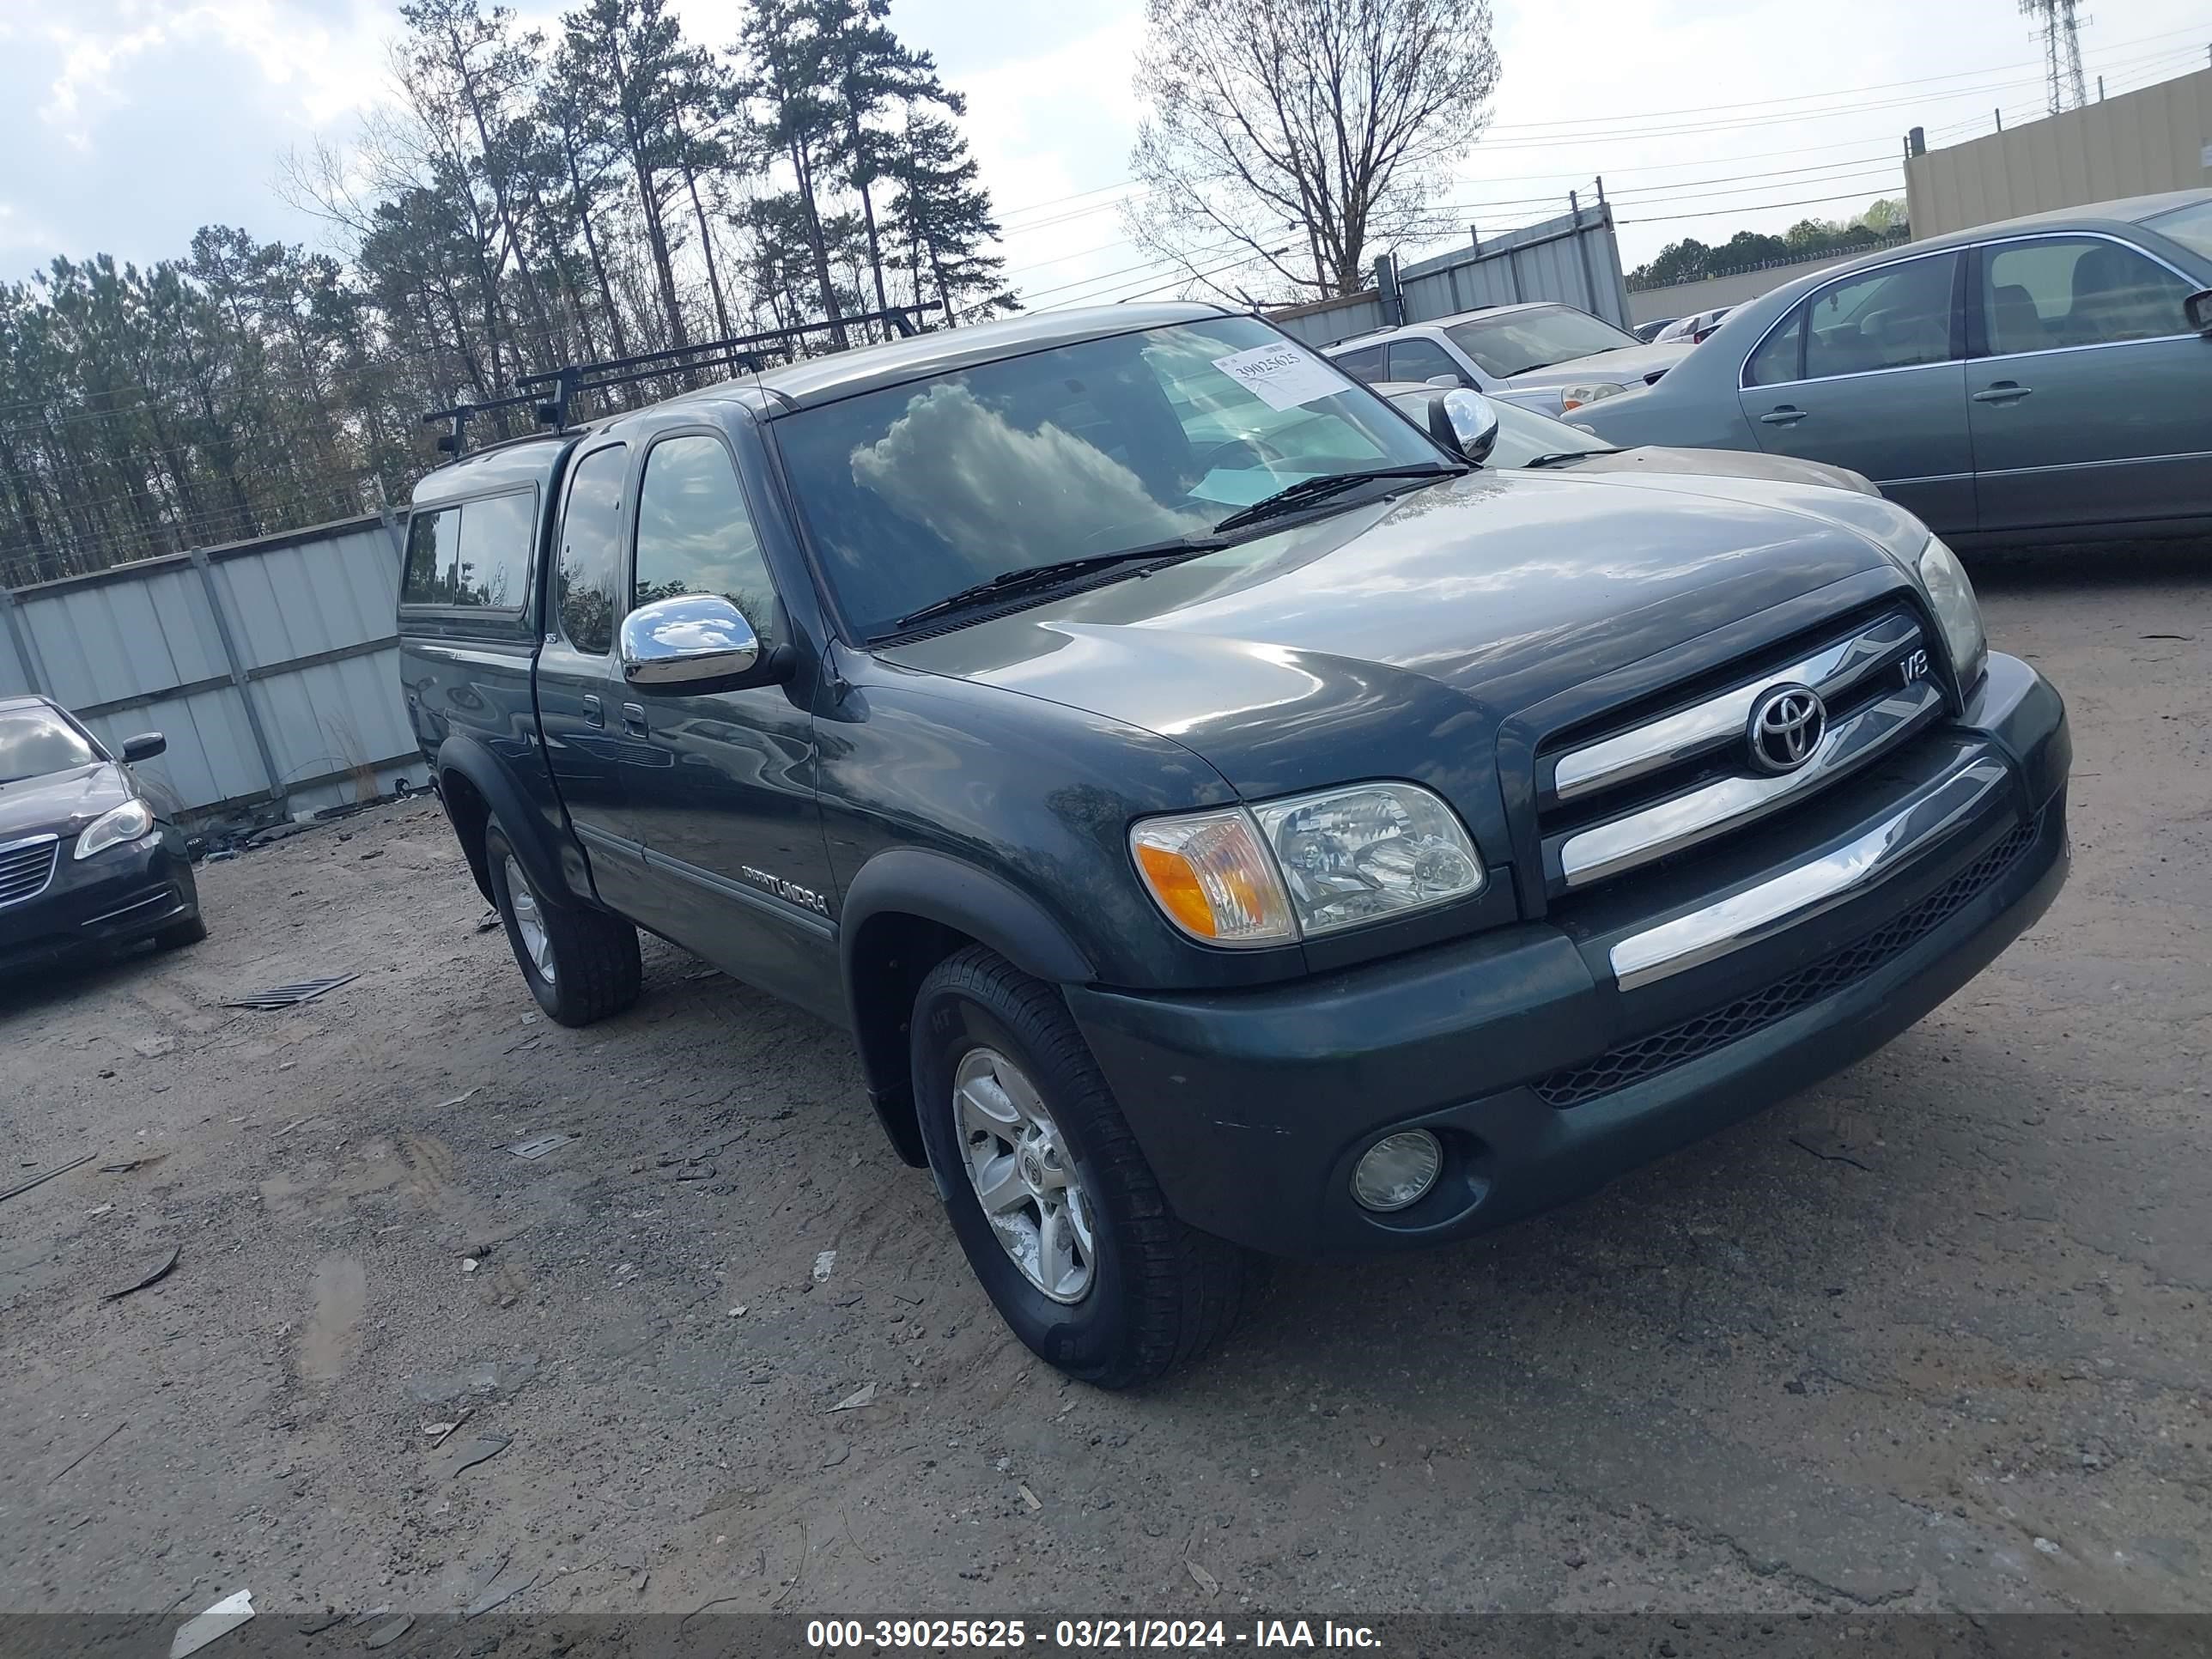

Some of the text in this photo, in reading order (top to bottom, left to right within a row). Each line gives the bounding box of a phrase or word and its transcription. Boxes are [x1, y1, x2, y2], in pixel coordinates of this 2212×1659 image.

[1235, 353, 1301, 379] 39025625
[1899, 648, 1929, 688] V8
[766, 874, 830, 915] TUNDRA
